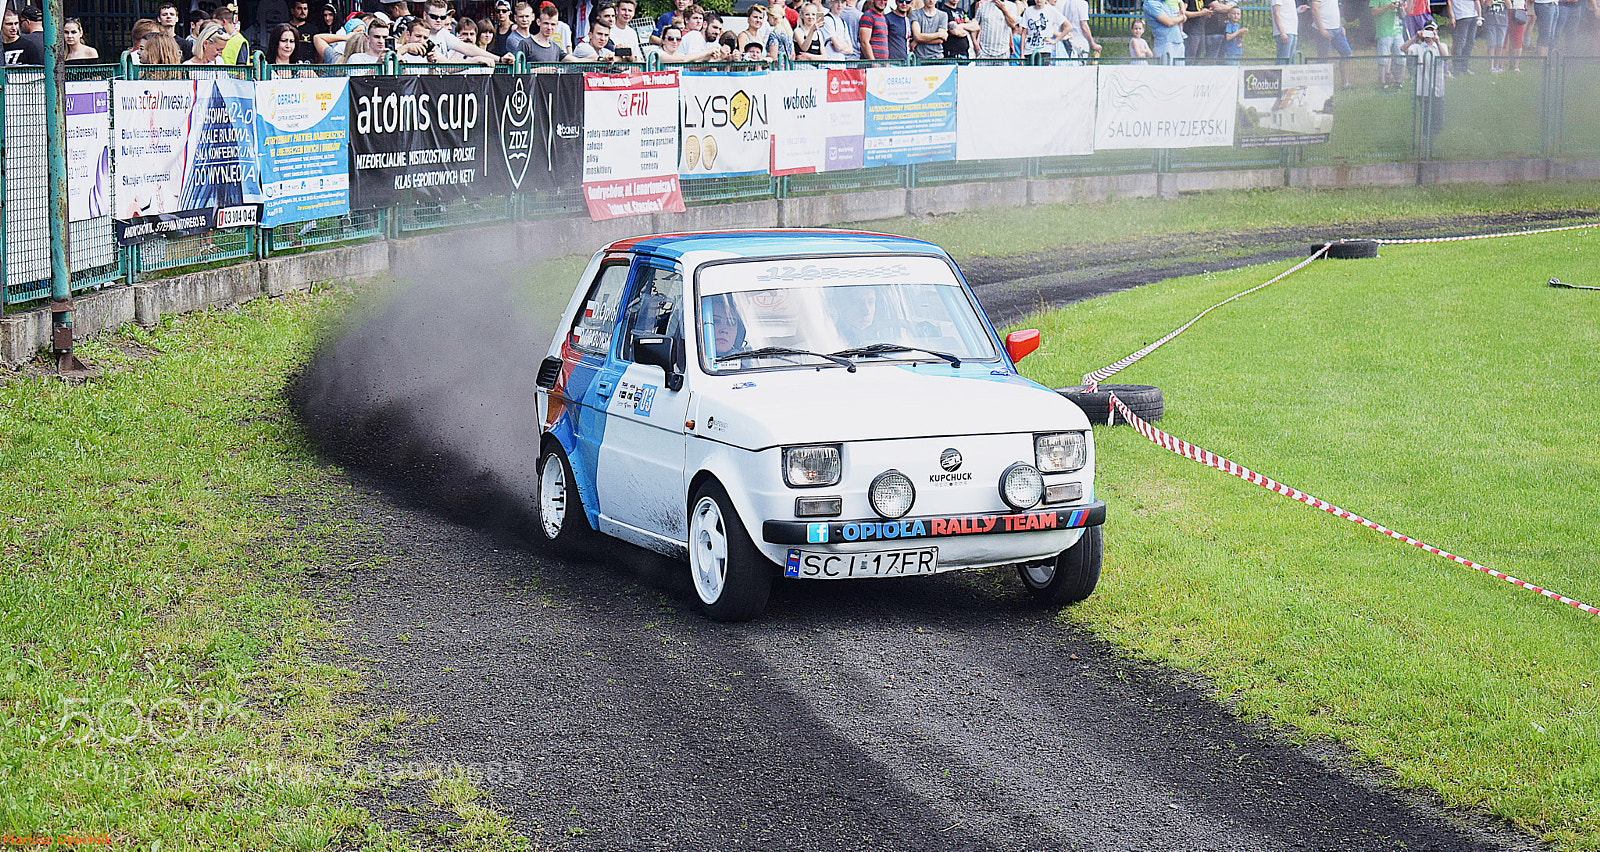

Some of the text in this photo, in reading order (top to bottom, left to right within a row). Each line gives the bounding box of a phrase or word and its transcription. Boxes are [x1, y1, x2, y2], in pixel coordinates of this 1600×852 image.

[1252, 77, 1279, 91] Rozbud
[630, 91, 648, 116] Fill
[783, 87, 817, 110] weboski
[357, 86, 478, 142] atoms cup
[743, 130, 769, 142] POLAND
[1108, 119, 1227, 138] SALON FRYZJERSKI
[509, 130, 529, 150] ZDZ
[409, 149, 451, 166] MISTRZOSTWA
[452, 146, 476, 163] POLSKI
[394, 174, 411, 190] KLAS
[459, 169, 475, 186] KĘTY
[640, 388, 655, 412] 03
[929, 472, 973, 483] KUPCHUCK
[842, 519, 926, 542] OPIOŁA
[930, 515, 997, 536] RALLY
[1001, 511, 1056, 531] TEAM
[787, 564, 798, 573] PL
[872, 551, 935, 575] 17FR
